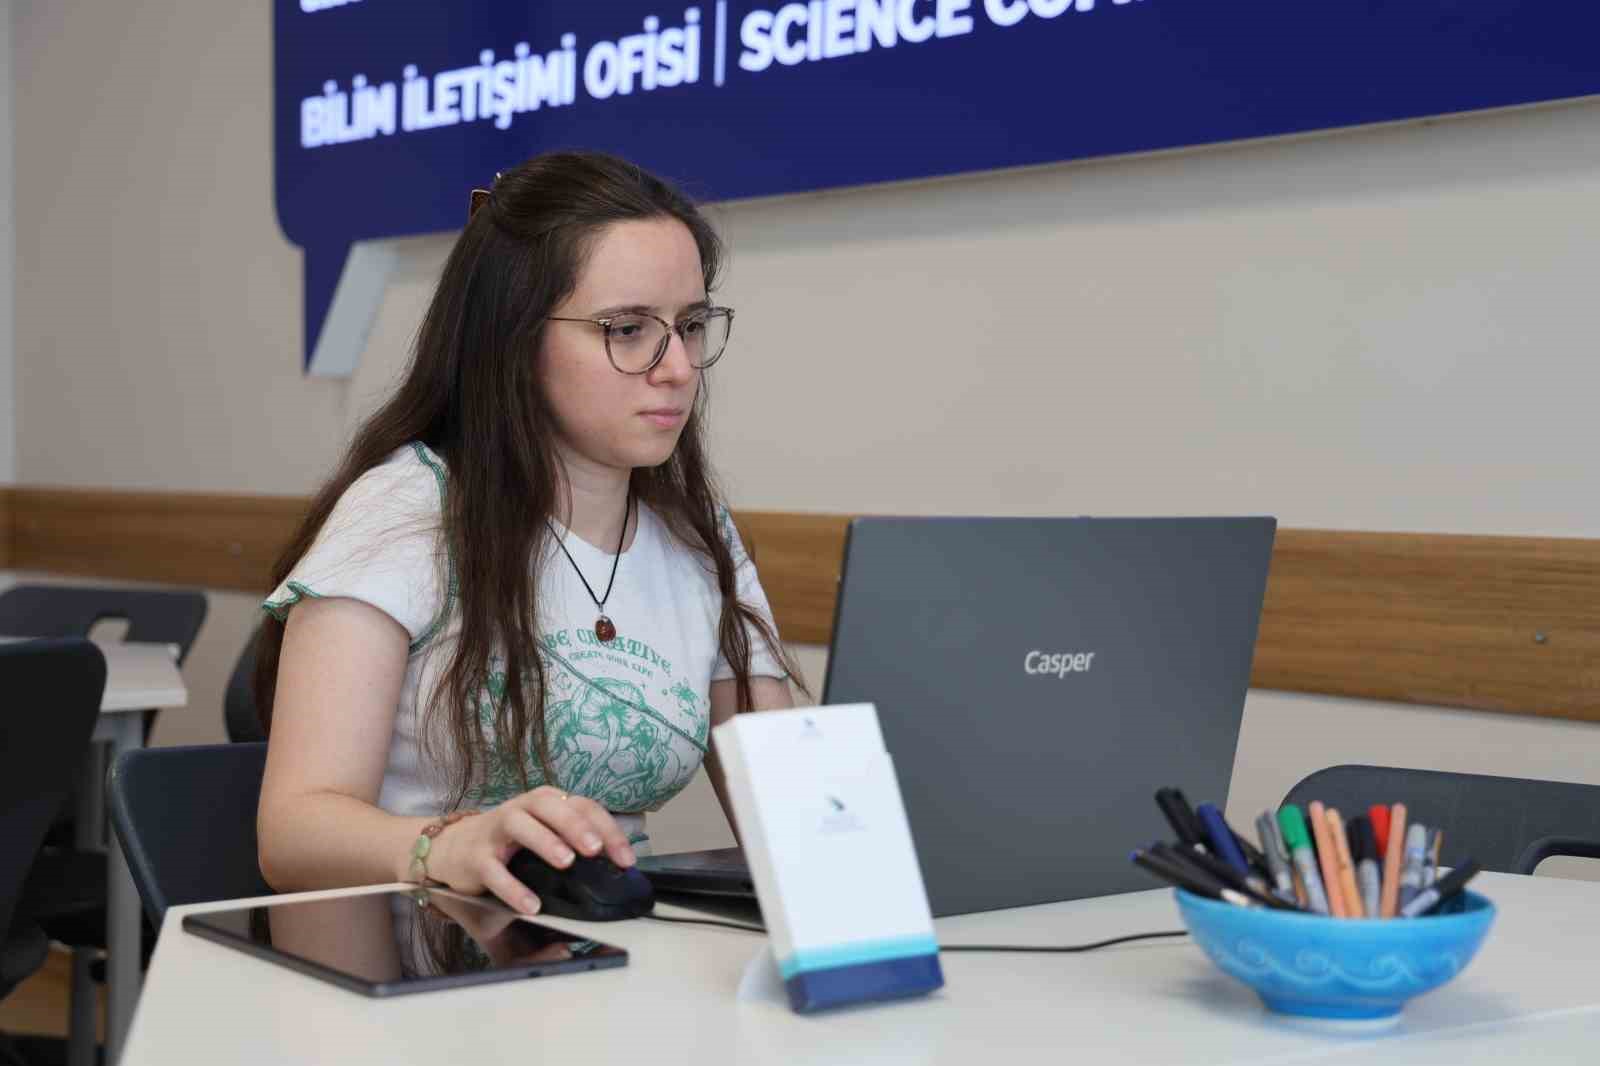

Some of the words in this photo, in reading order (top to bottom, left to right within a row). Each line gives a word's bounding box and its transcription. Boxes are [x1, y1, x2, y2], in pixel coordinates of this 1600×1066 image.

[301, 75, 397, 149] BİLİM
[402, 32, 577, 130] İLETİŞİMİ
[584, 6, 700, 99] OFİSİ
[738, 0, 973, 71] SCIENCE
[1024, 650, 1096, 679] Casper
